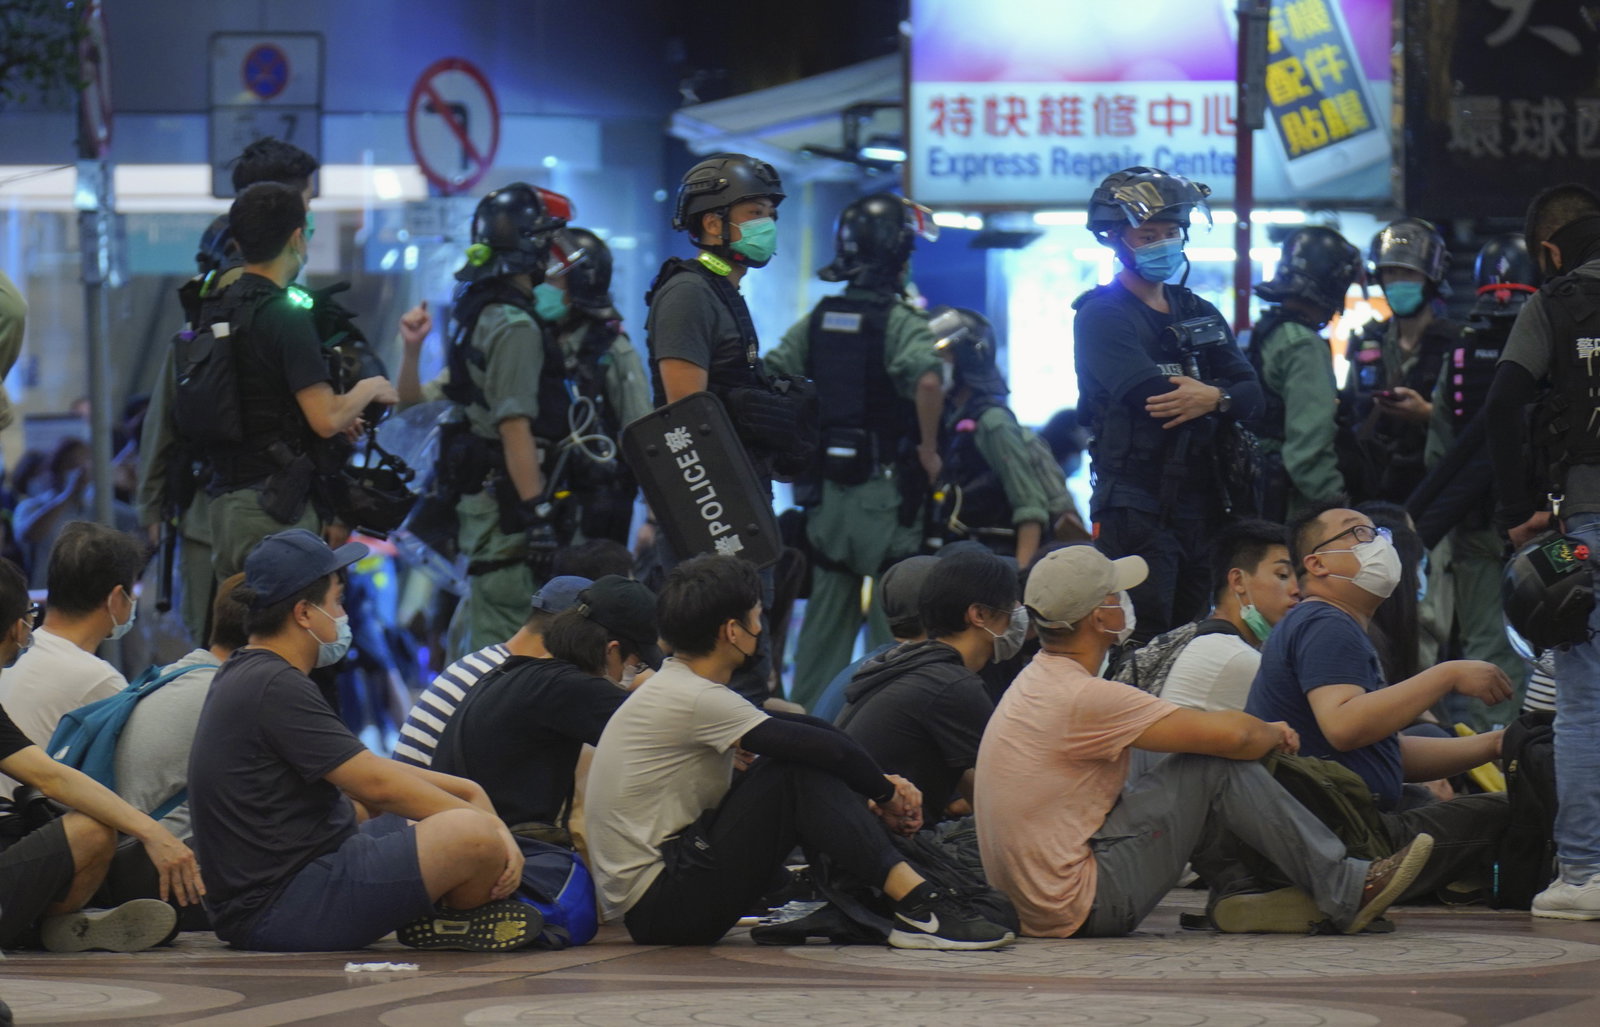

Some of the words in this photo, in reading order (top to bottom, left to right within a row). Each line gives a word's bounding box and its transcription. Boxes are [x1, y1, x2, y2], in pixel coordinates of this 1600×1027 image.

[1266, 43, 1348, 107] 配件
[928, 146, 1041, 184] Express
[1050, 146, 1144, 181] Repair
[1153, 145, 1237, 177] Cente
